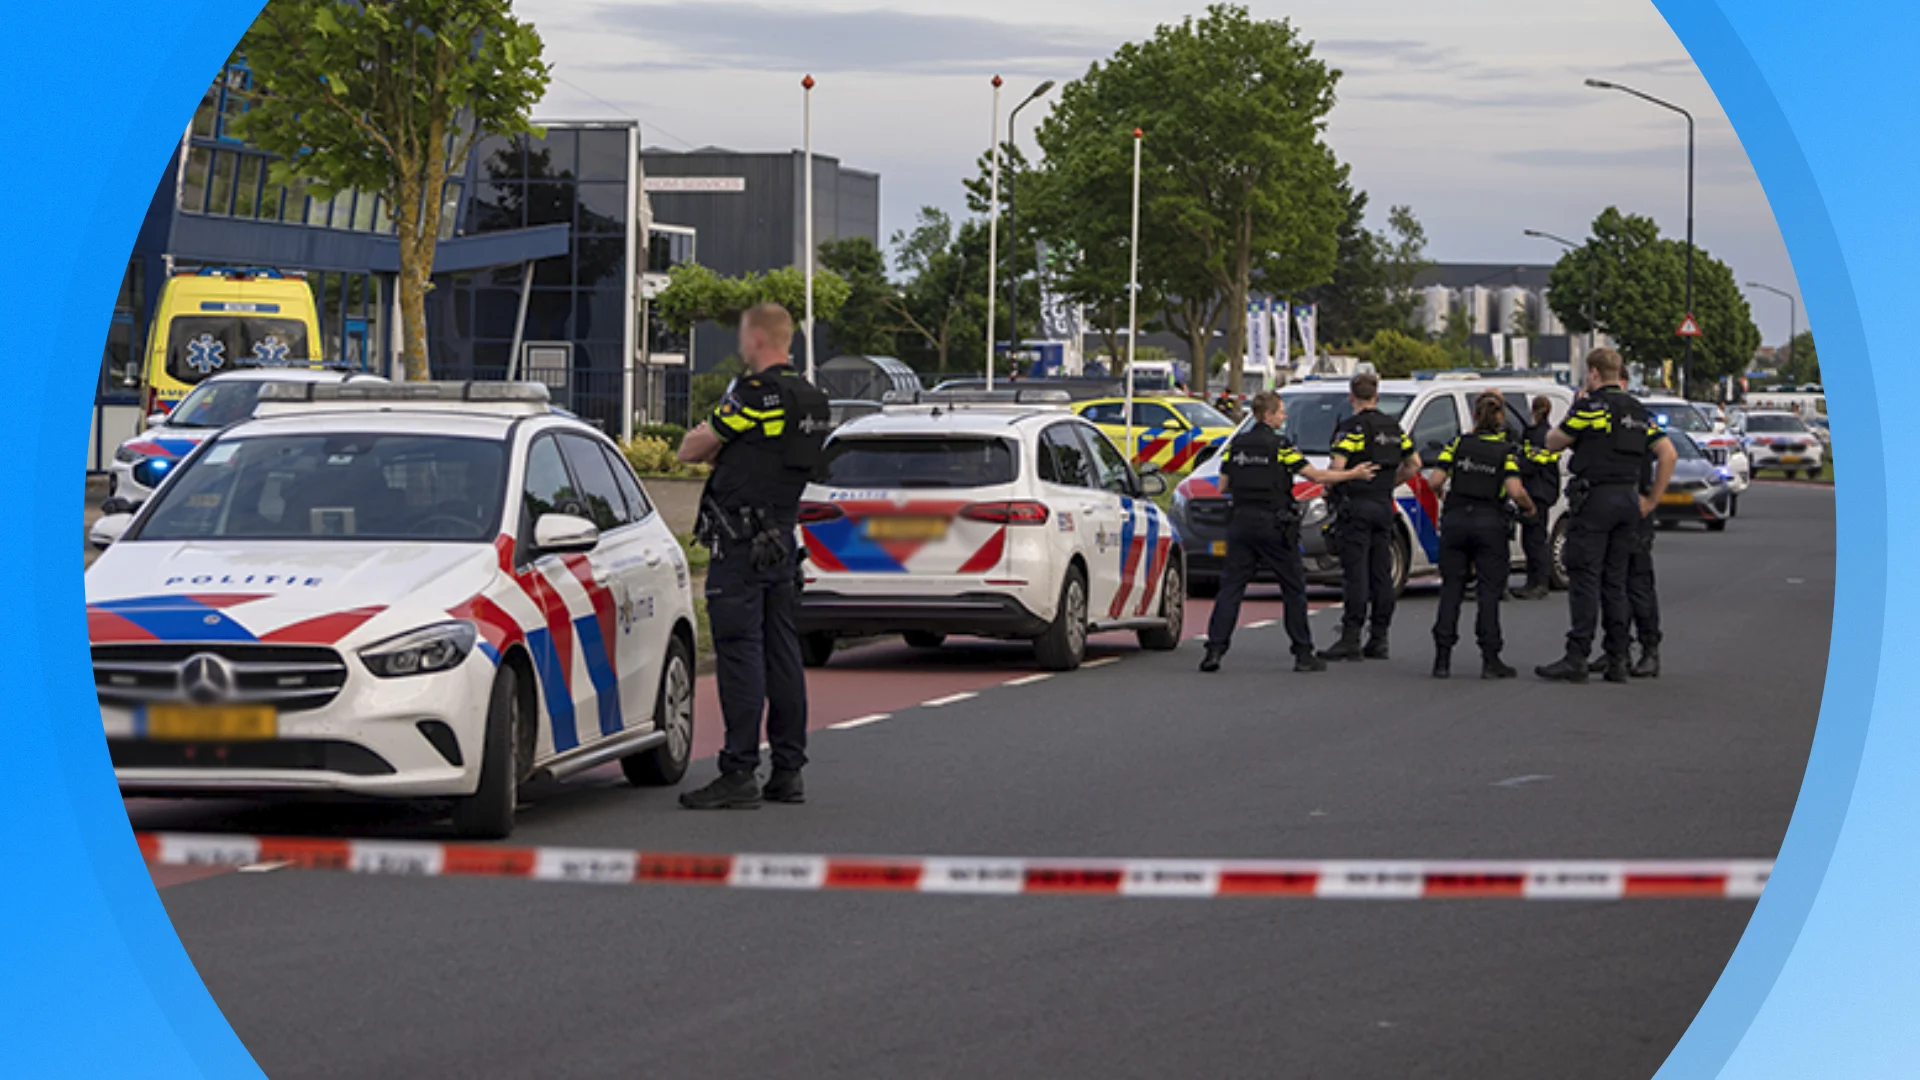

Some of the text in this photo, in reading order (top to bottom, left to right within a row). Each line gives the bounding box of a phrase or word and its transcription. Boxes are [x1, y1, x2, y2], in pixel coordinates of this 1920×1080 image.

[682, 178, 741, 190] SERVICES
[828, 490, 889, 500] POLITIE
[164, 574, 324, 587] POLITIE
